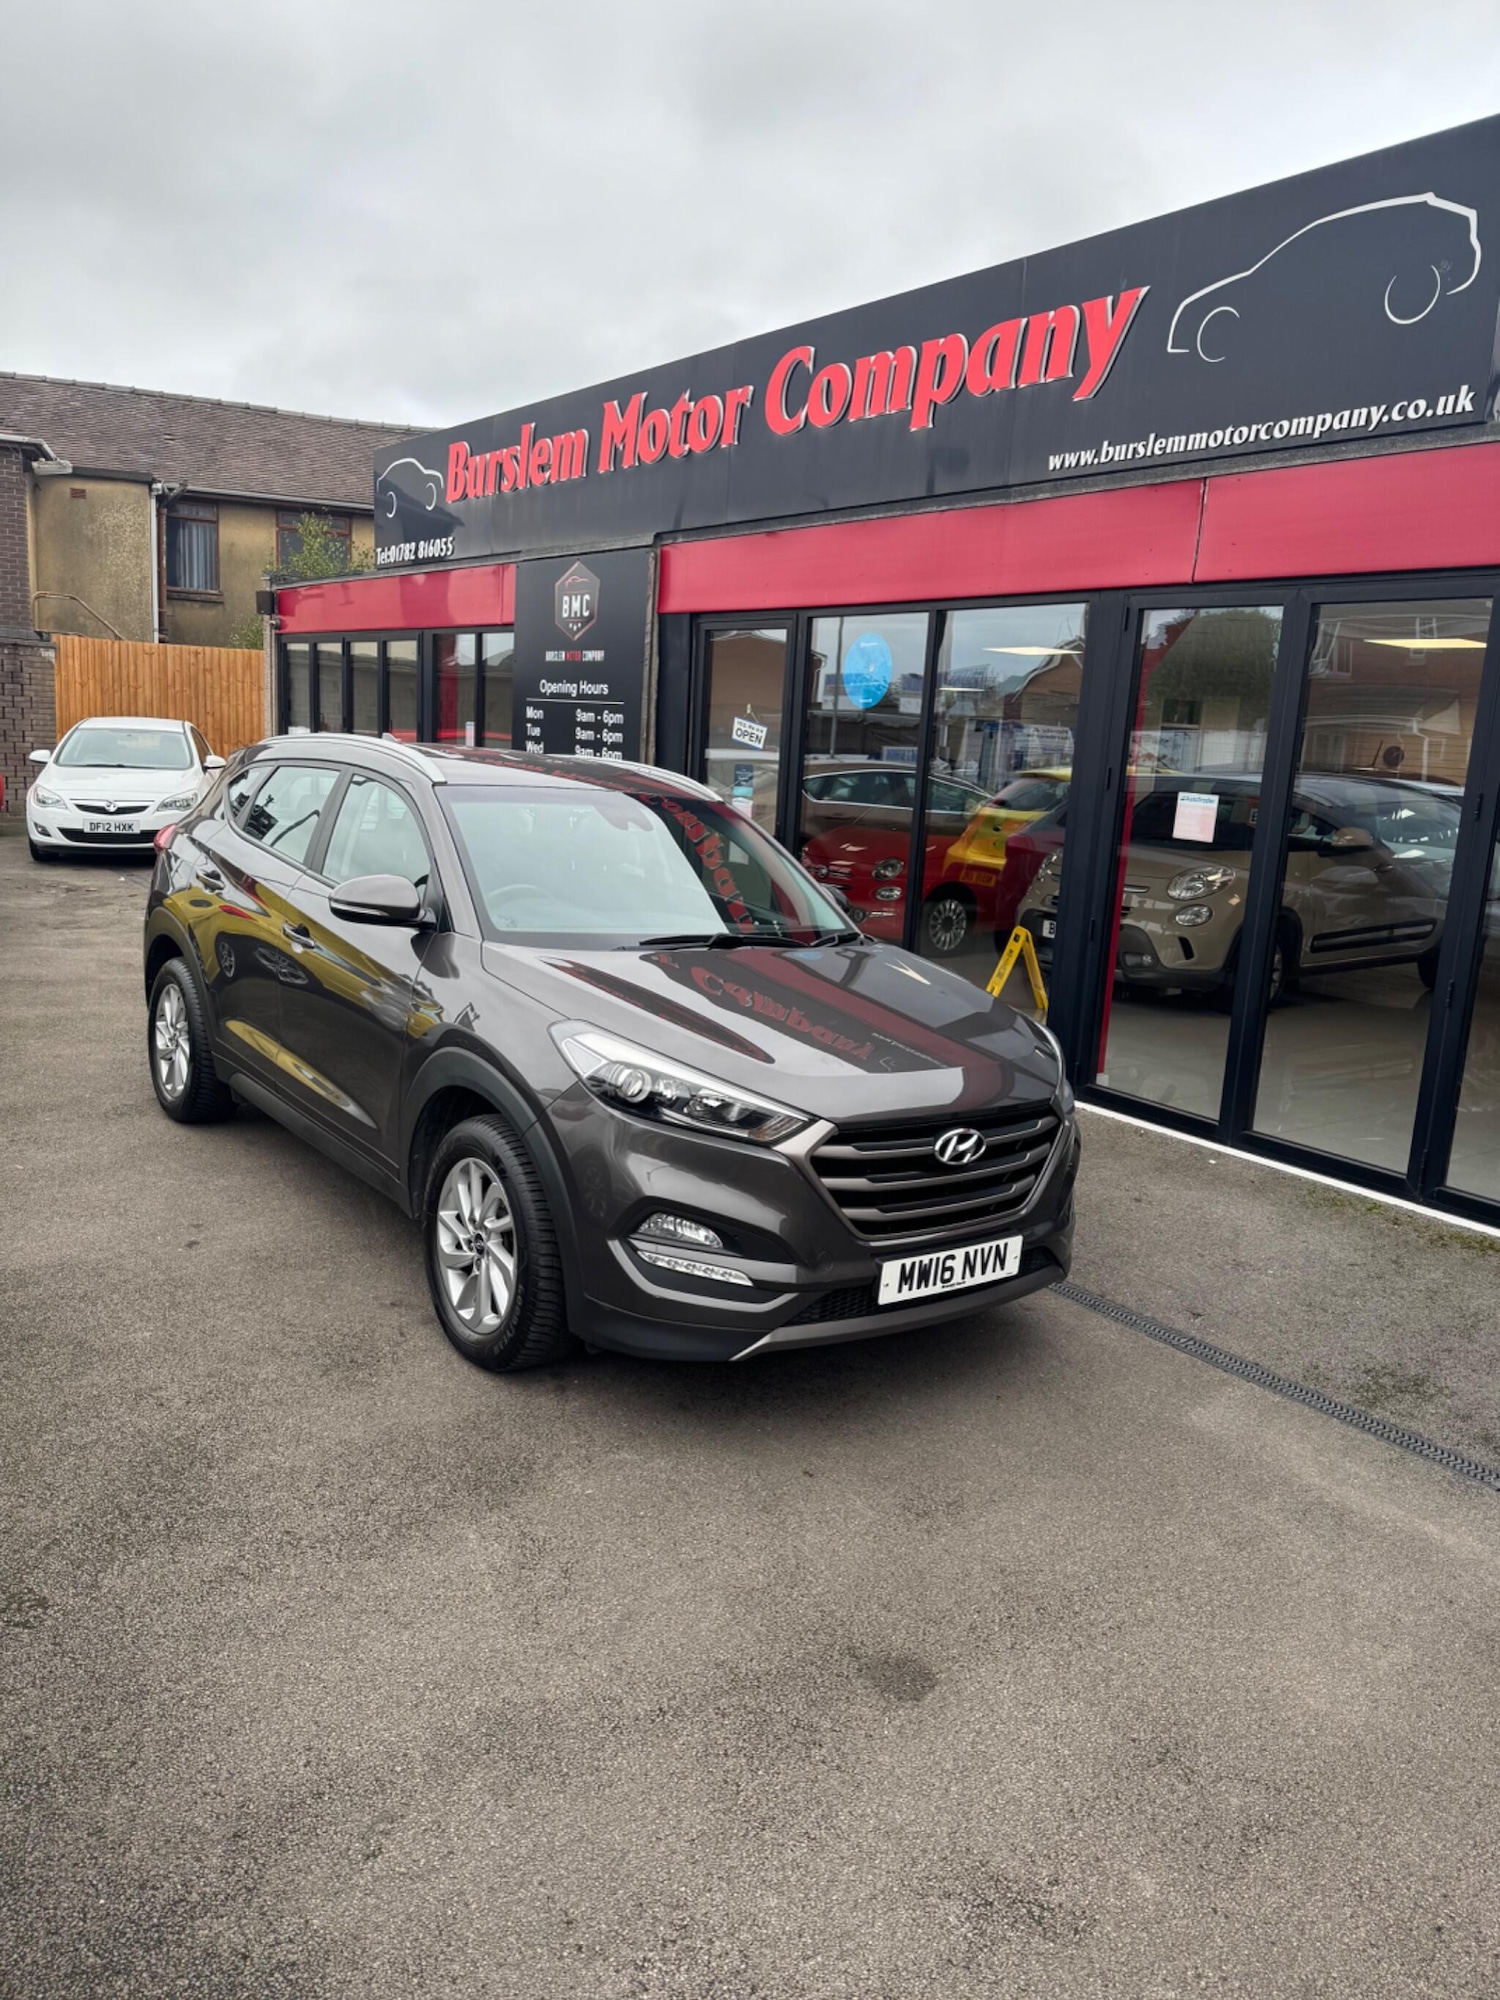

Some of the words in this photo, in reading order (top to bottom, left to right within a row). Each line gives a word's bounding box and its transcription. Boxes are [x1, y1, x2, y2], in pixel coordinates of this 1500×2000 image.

[445, 423, 589, 504] Burslem
[598, 385, 754, 474] Motor
[764, 285, 1151, 436] Company
[1048, 384, 1475, 471] www.burslemmotorcompany.co.uk
[417, 536, 454, 559] 816055
[562, 594, 591, 618] BMC
[539, 679, 578, 698] Opening
[579, 680, 609, 695] Hours
[526, 706, 544, 720] Mon
[575, 708, 595, 723] 9am
[602, 710, 624, 727] 6pm
[526, 723, 541, 736] Tue
[575, 726, 595, 740] 9am
[602, 728, 623, 745] 6pm
[735, 727, 763, 745] OPEN
[525, 741, 544, 754] Wed
[89, 822, 112, 832] DF12
[114, 822, 134, 832] HXK
[897, 1253, 957, 1294] MW16
[961, 1241, 1009, 1281] NVN
